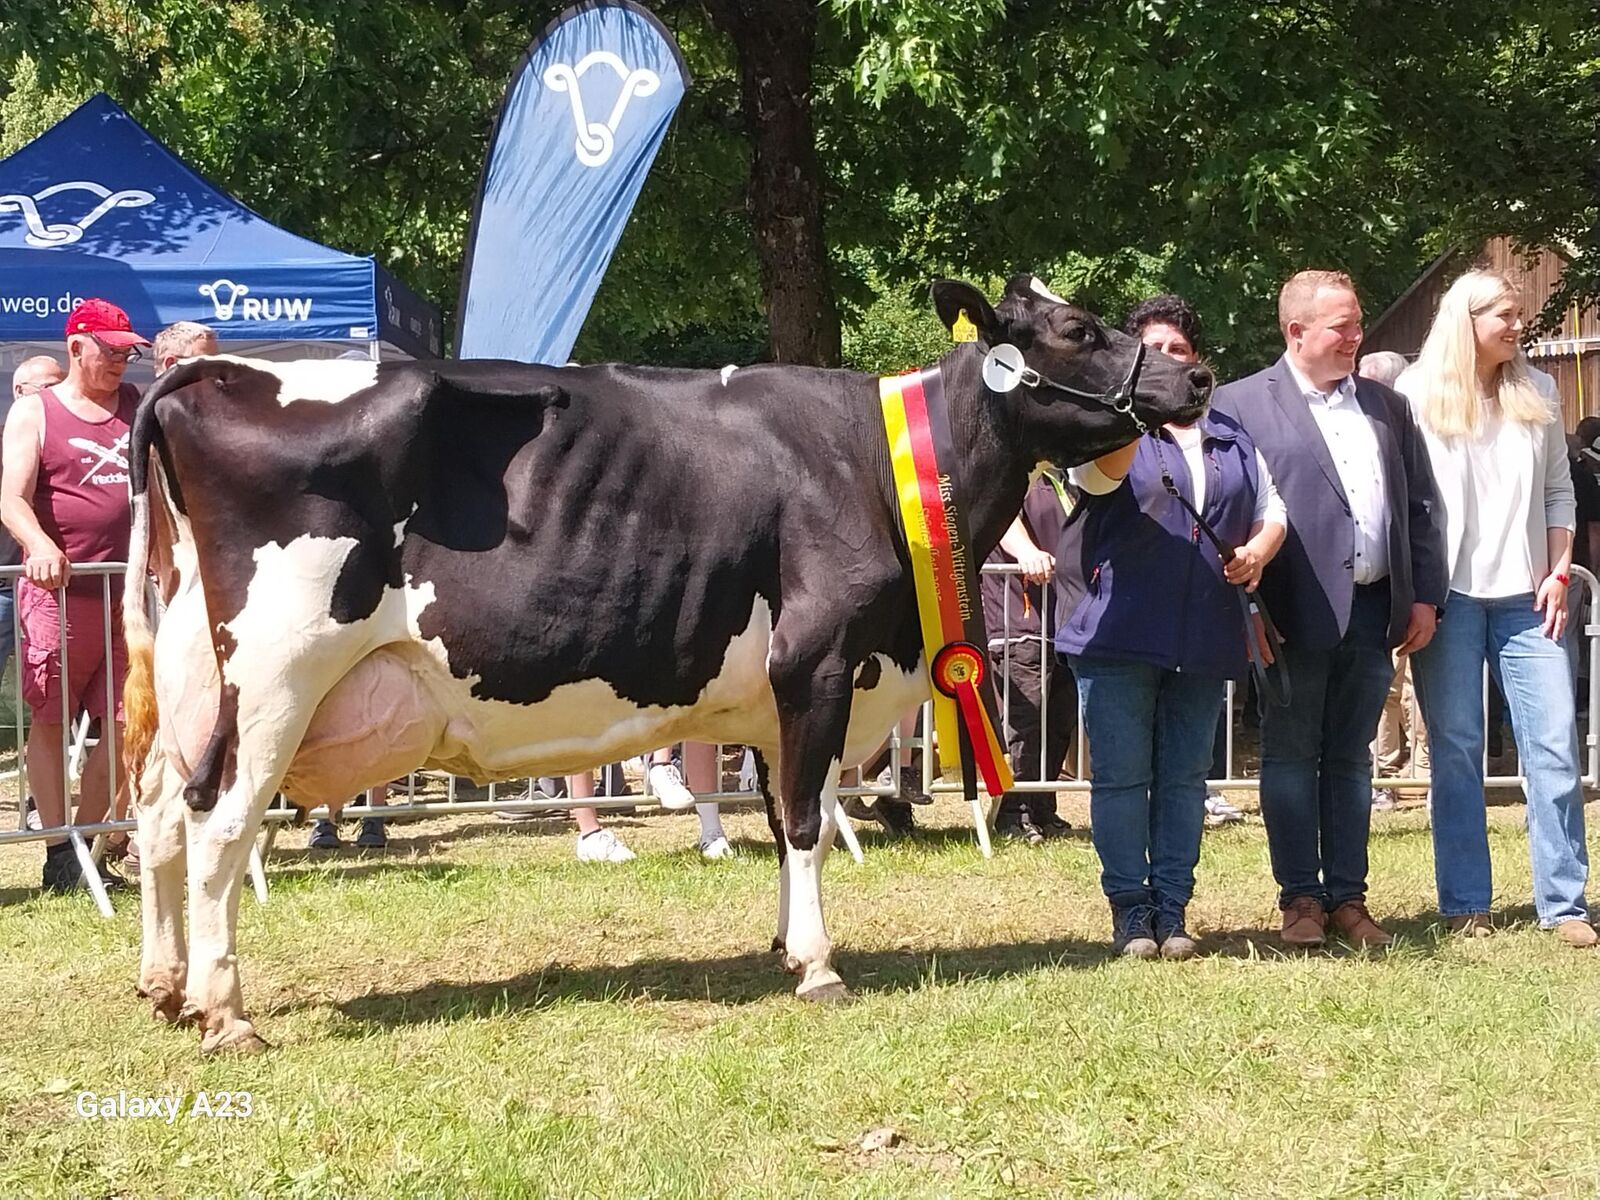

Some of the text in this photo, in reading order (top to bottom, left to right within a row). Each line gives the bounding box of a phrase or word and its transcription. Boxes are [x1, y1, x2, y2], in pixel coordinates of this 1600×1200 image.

[0, 291, 85, 318] weg.de
[243, 298, 312, 321] RUW
[994, 357, 1015, 373] 1
[936, 474, 973, 621] Miss Siegen-Wittgenstein
